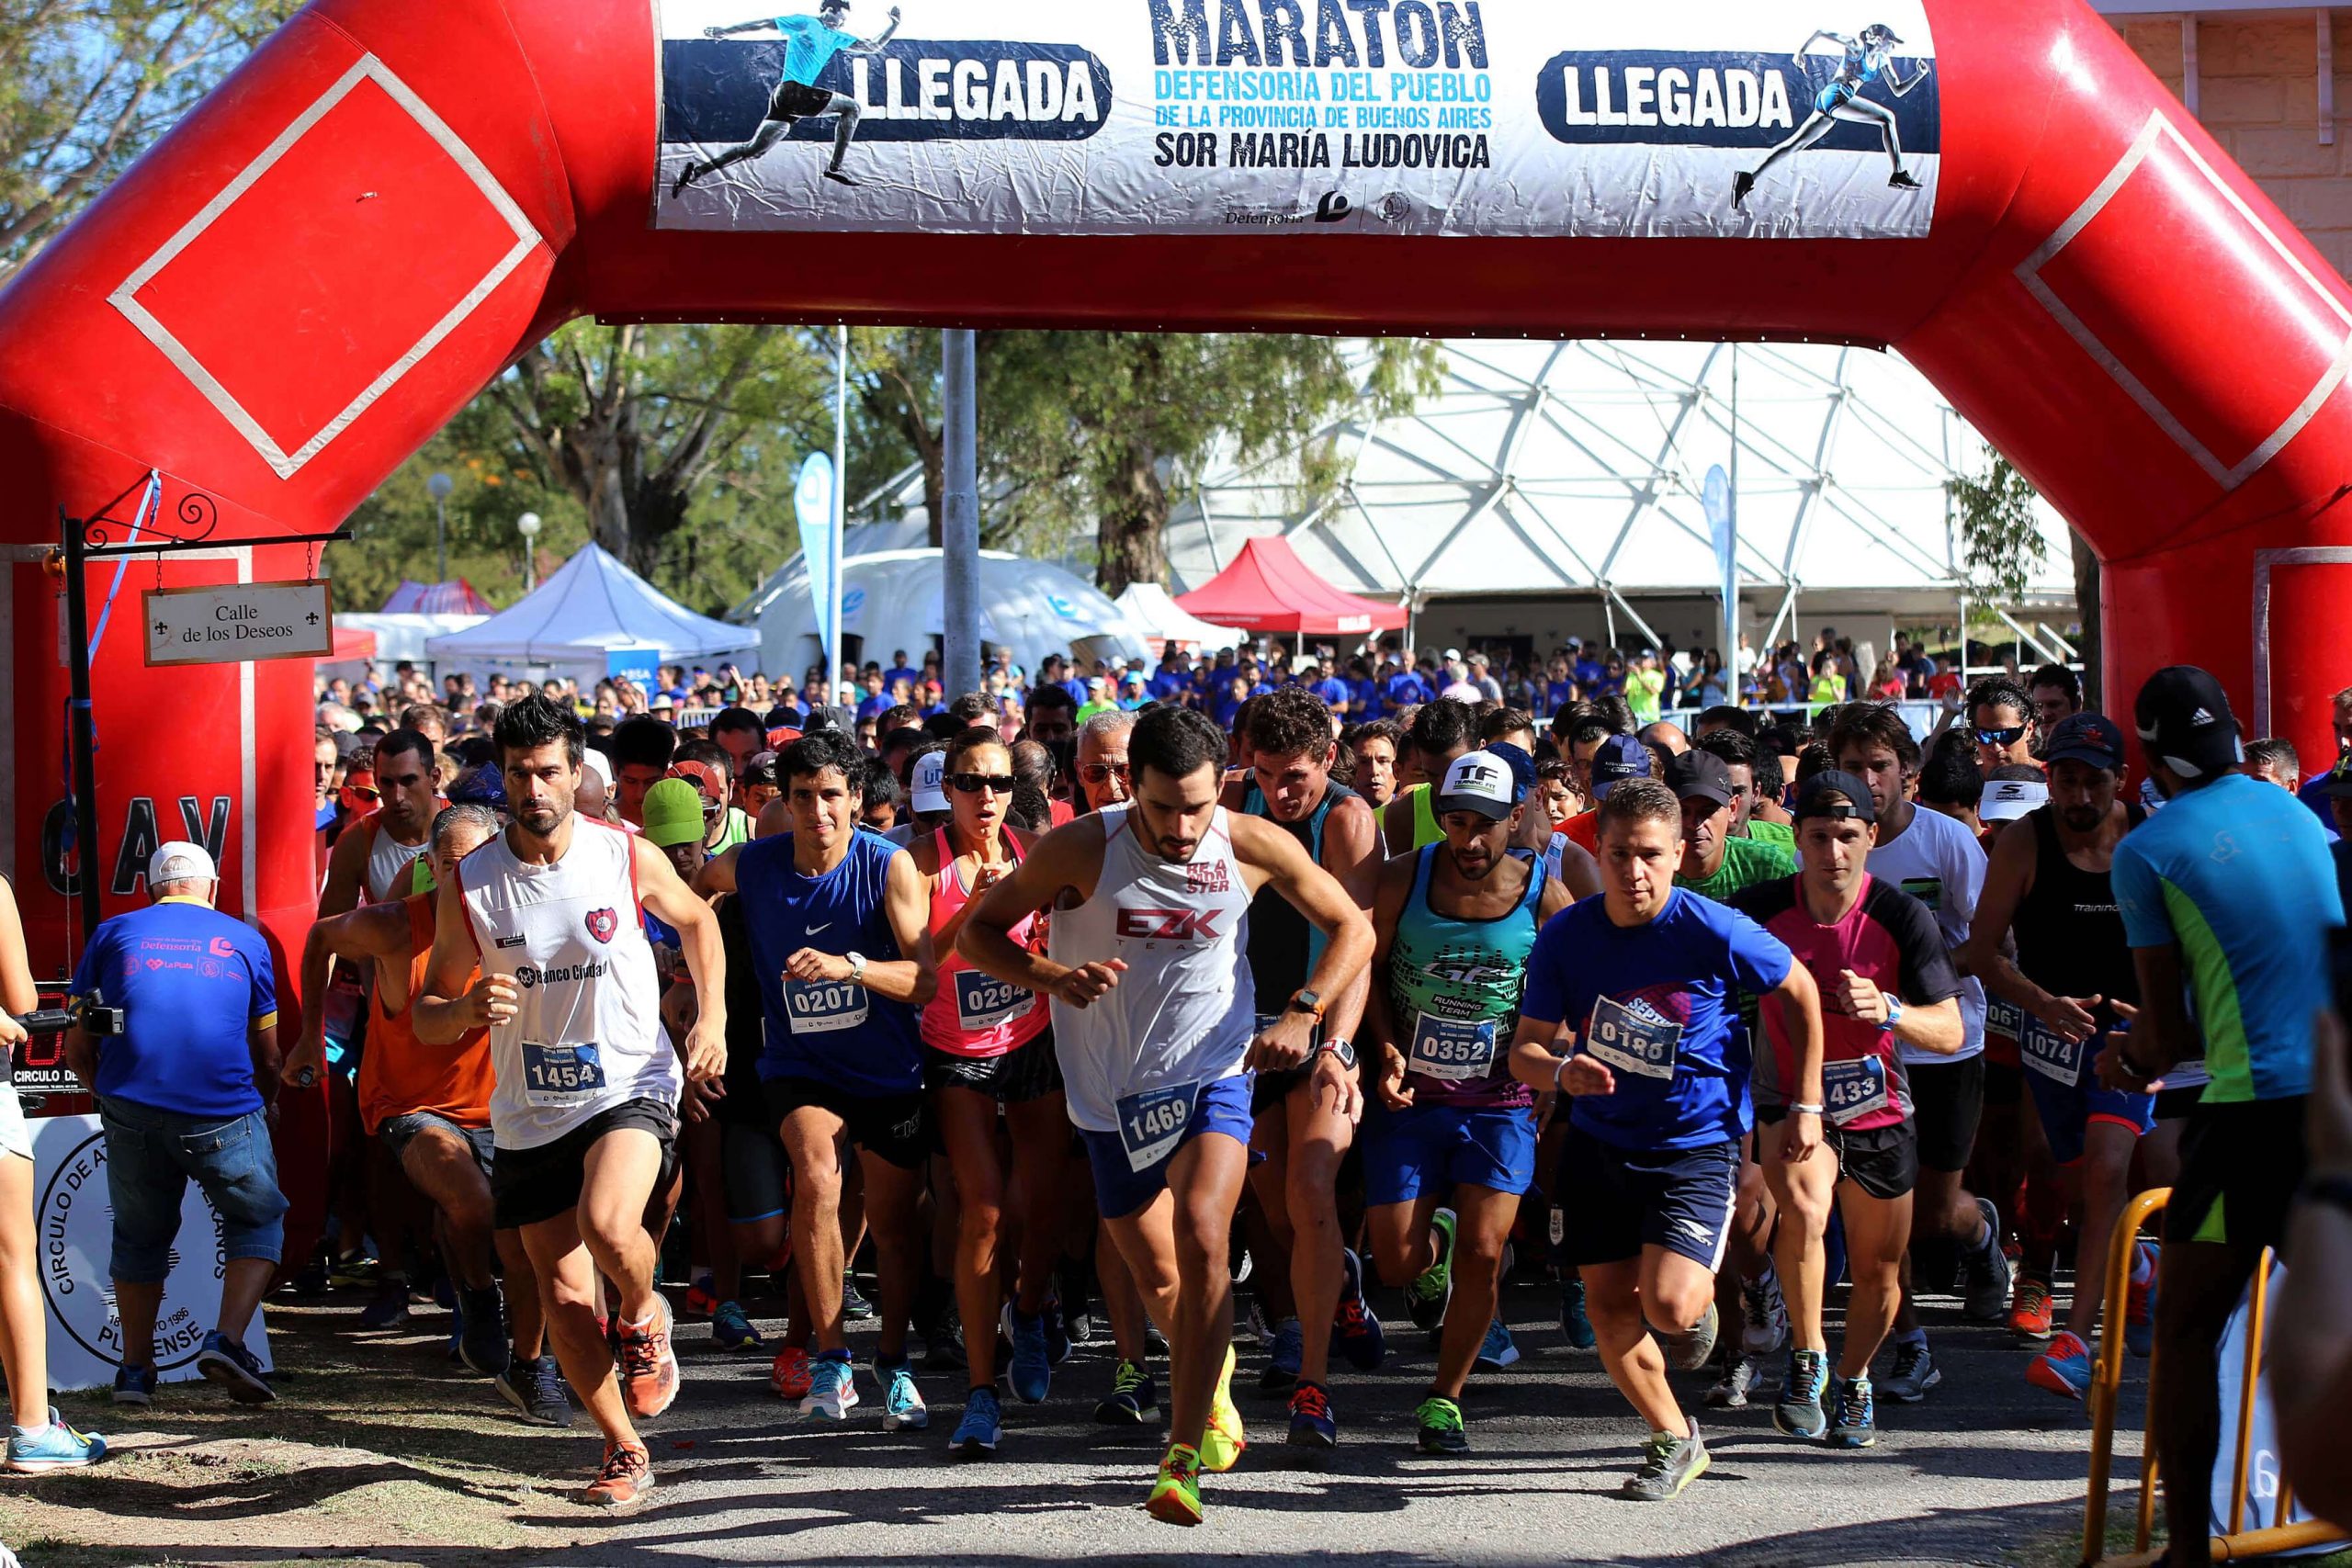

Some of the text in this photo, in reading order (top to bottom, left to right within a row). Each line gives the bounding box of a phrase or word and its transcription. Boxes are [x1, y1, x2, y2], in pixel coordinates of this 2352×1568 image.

[851, 58, 1100, 123] LLEGADA
[1331, 72, 1381, 102] DEL
[1391, 73, 1491, 102] PUEBLO
[1563, 65, 1793, 130] LLEGADA
[1155, 106, 1492, 130] DE LA PROVINCIA DE BUENOS AIRES
[1154, 128, 1490, 168] SOR MARÍA LUDOVICA
[215, 605, 258, 622] Calle
[183, 624, 293, 643] de los Deseos
[1186, 881, 1229, 894] STER
[1116, 908, 1225, 941] EZK
[536, 960, 607, 984] Banco Ciudad
[794, 985, 854, 1013] 0207
[968, 984, 1026, 1010] 0294
[1433, 996, 1482, 1010] RUNNING
[1440, 1005, 1471, 1017] TEAM
[1422, 1036, 1487, 1061] 0352
[2027, 1031, 2073, 1064] 1074
[14, 1070, 79, 1083] CIRCULO DE
[532, 1065, 595, 1088] 1454
[1829, 1077, 1876, 1105] 433
[1129, 1099, 1186, 1142] 1469
[49, 1159, 93, 1295] CÍRCULO DE
[109, 1314, 121, 1327] 18
[167, 1306, 189, 1327] 1986
[97, 1320, 204, 1358] PLENSE
